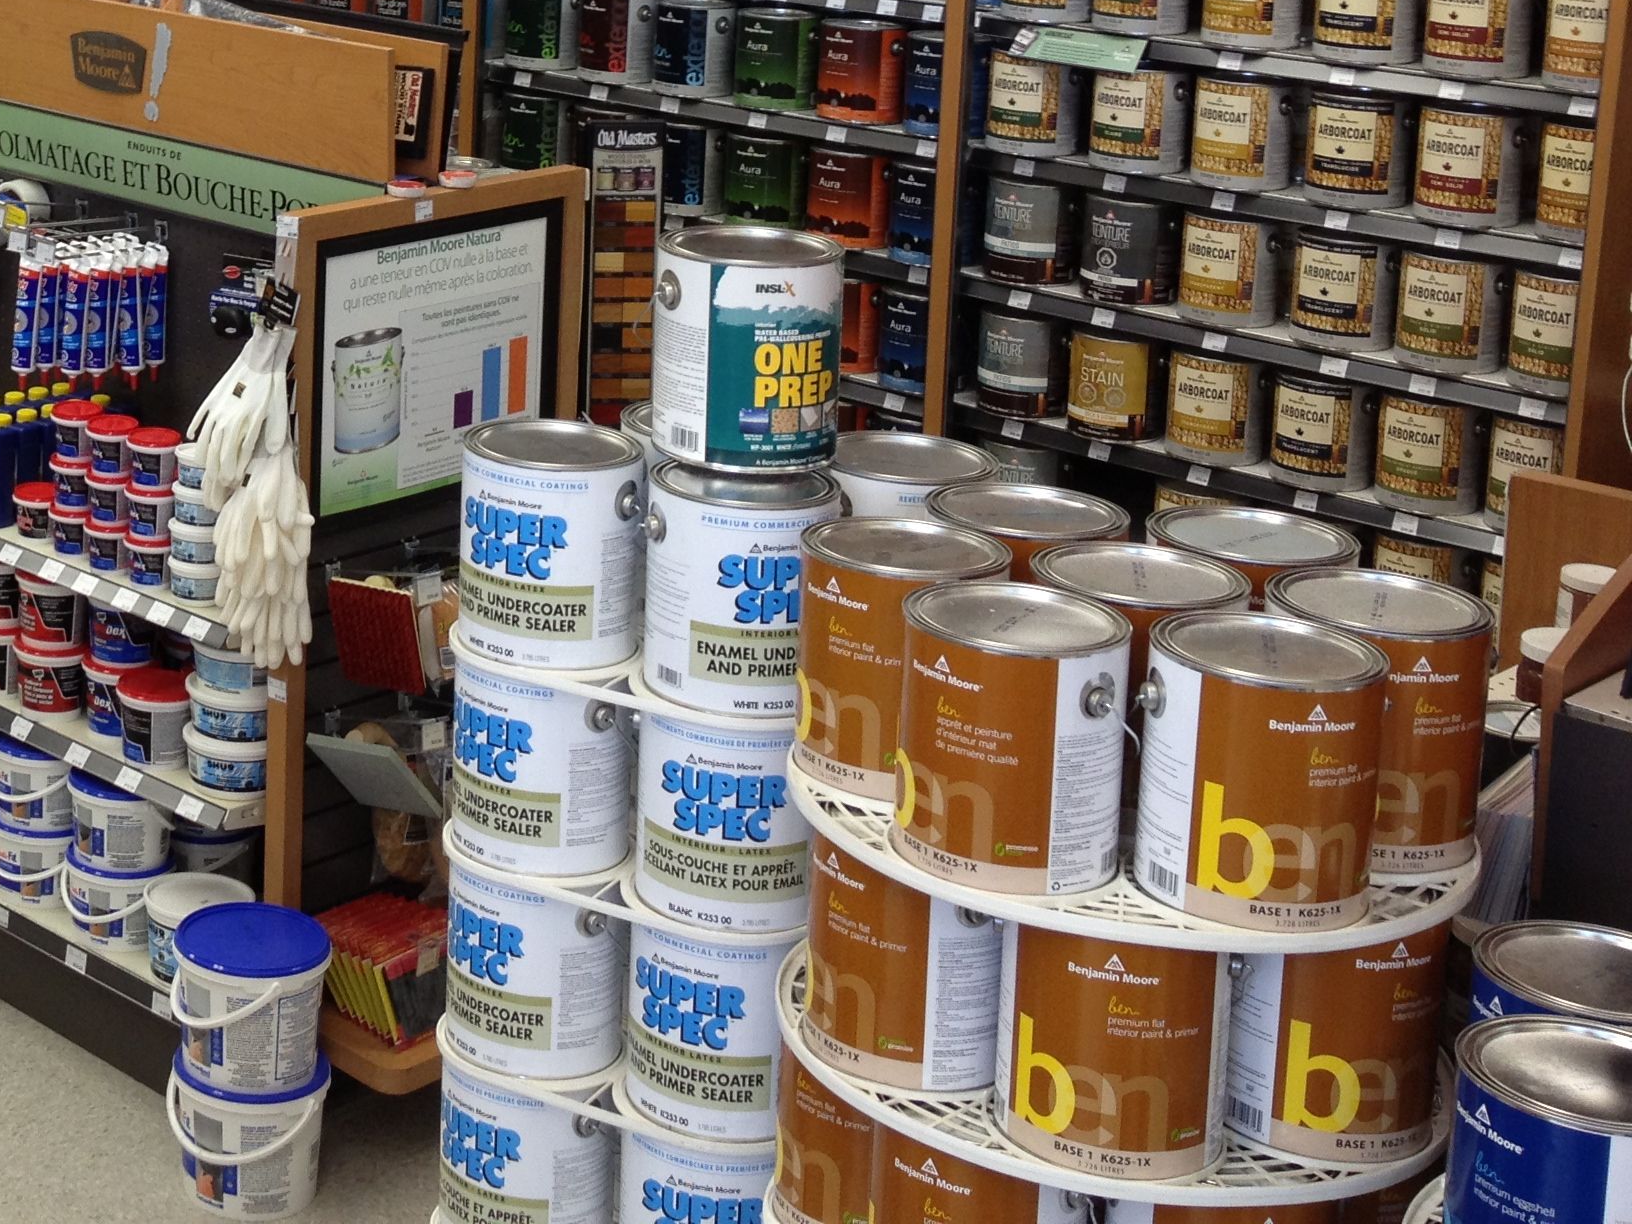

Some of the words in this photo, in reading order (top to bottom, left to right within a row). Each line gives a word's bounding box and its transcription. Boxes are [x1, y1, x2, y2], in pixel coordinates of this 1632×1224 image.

[77, 38, 136, 63] Benjamin
[747, 40, 768, 52] Aura
[828, 49, 848, 62] Aura
[78, 56, 120, 80] Moore
[915, 64, 937, 76] Aura
[1200, 107, 1247, 123] ARBORCOAT
[598, 129, 615, 146] Old
[615, 130, 657, 148] Masters
[1318, 124, 1372, 140] ARBORCOAT
[127, 140, 167, 158] ENDUITS
[168, 150, 183, 161] DE
[1426, 139, 1481, 157] ARBORCOAT
[123, 160, 151, 191] ET
[739, 162, 762, 175] Aura
[819, 178, 840, 190] Aura
[900, 192, 922, 205] Aura
[377, 241, 428, 265] Benjamin
[430, 237, 464, 254] Moore
[466, 230, 501, 247] Natura
[1188, 242, 1236, 261] ARBORCOAT
[1303, 264, 1356, 283] ARBORCOAT
[1408, 285, 1463, 304] ARBORCOAT
[1518, 304, 1572, 325] ARBORCOAT
[754, 339, 824, 375] ONE
[1080, 368, 1124, 387] STAIN
[754, 370, 833, 408] PREP
[1178, 382, 1230, 401] ARBORCOAT
[1280, 406, 1330, 424] ARBORCOAT
[1387, 427, 1441, 446] ARBORCOAT
[1495, 447, 1549, 467] ARBORCOAT
[540, 481, 589, 490] COATINGS
[487, 493, 517, 507] Benjamin
[465, 495, 568, 549] SUPER
[471, 532, 551, 581] SPEC
[487, 591, 587, 617] UNDERCOATER
[477, 605, 520, 628] PRIMER
[525, 616, 576, 633] SEALER
[697, 641, 758, 661] ENAMEL
[707, 659, 742, 676] AND
[913, 659, 946, 682] Benjamin
[947, 676, 980, 692] Moore
[1269, 719, 1322, 734] Benjamin
[1323, 720, 1356, 732] Moore
[661, 759, 787, 808] SUPER
[673, 798, 771, 843] SPEC
[649, 839, 728, 875] SOUS-COUCHE
[733, 864, 747, 875] ET
[645, 850, 686, 880] SCELLANT
[690, 871, 727, 889] LATEX
[732, 878, 768, 891] POUR
[1249, 905, 1282, 917] BASE
[1299, 905, 1341, 918] K625-1X
[1068, 961, 1119, 982] Benjamin
[1122, 973, 1160, 985] Moore
[635, 955, 746, 1019] SUPER
[642, 995, 728, 1051] SPEC
[1107, 1017, 1149, 1028] premium
[661, 1057, 764, 1087] UNDERCOATER
[649, 1068, 695, 1097] PRIMER
[701, 1086, 753, 1103] SEALER
[1488, 1127, 1524, 1156] Moore
[1054, 1140, 1084, 1158] BASE
[1100, 1153, 1152, 1167] K625-1X
[894, 1158, 934, 1187] Benjamin
[936, 1176, 971, 1195] Moore
